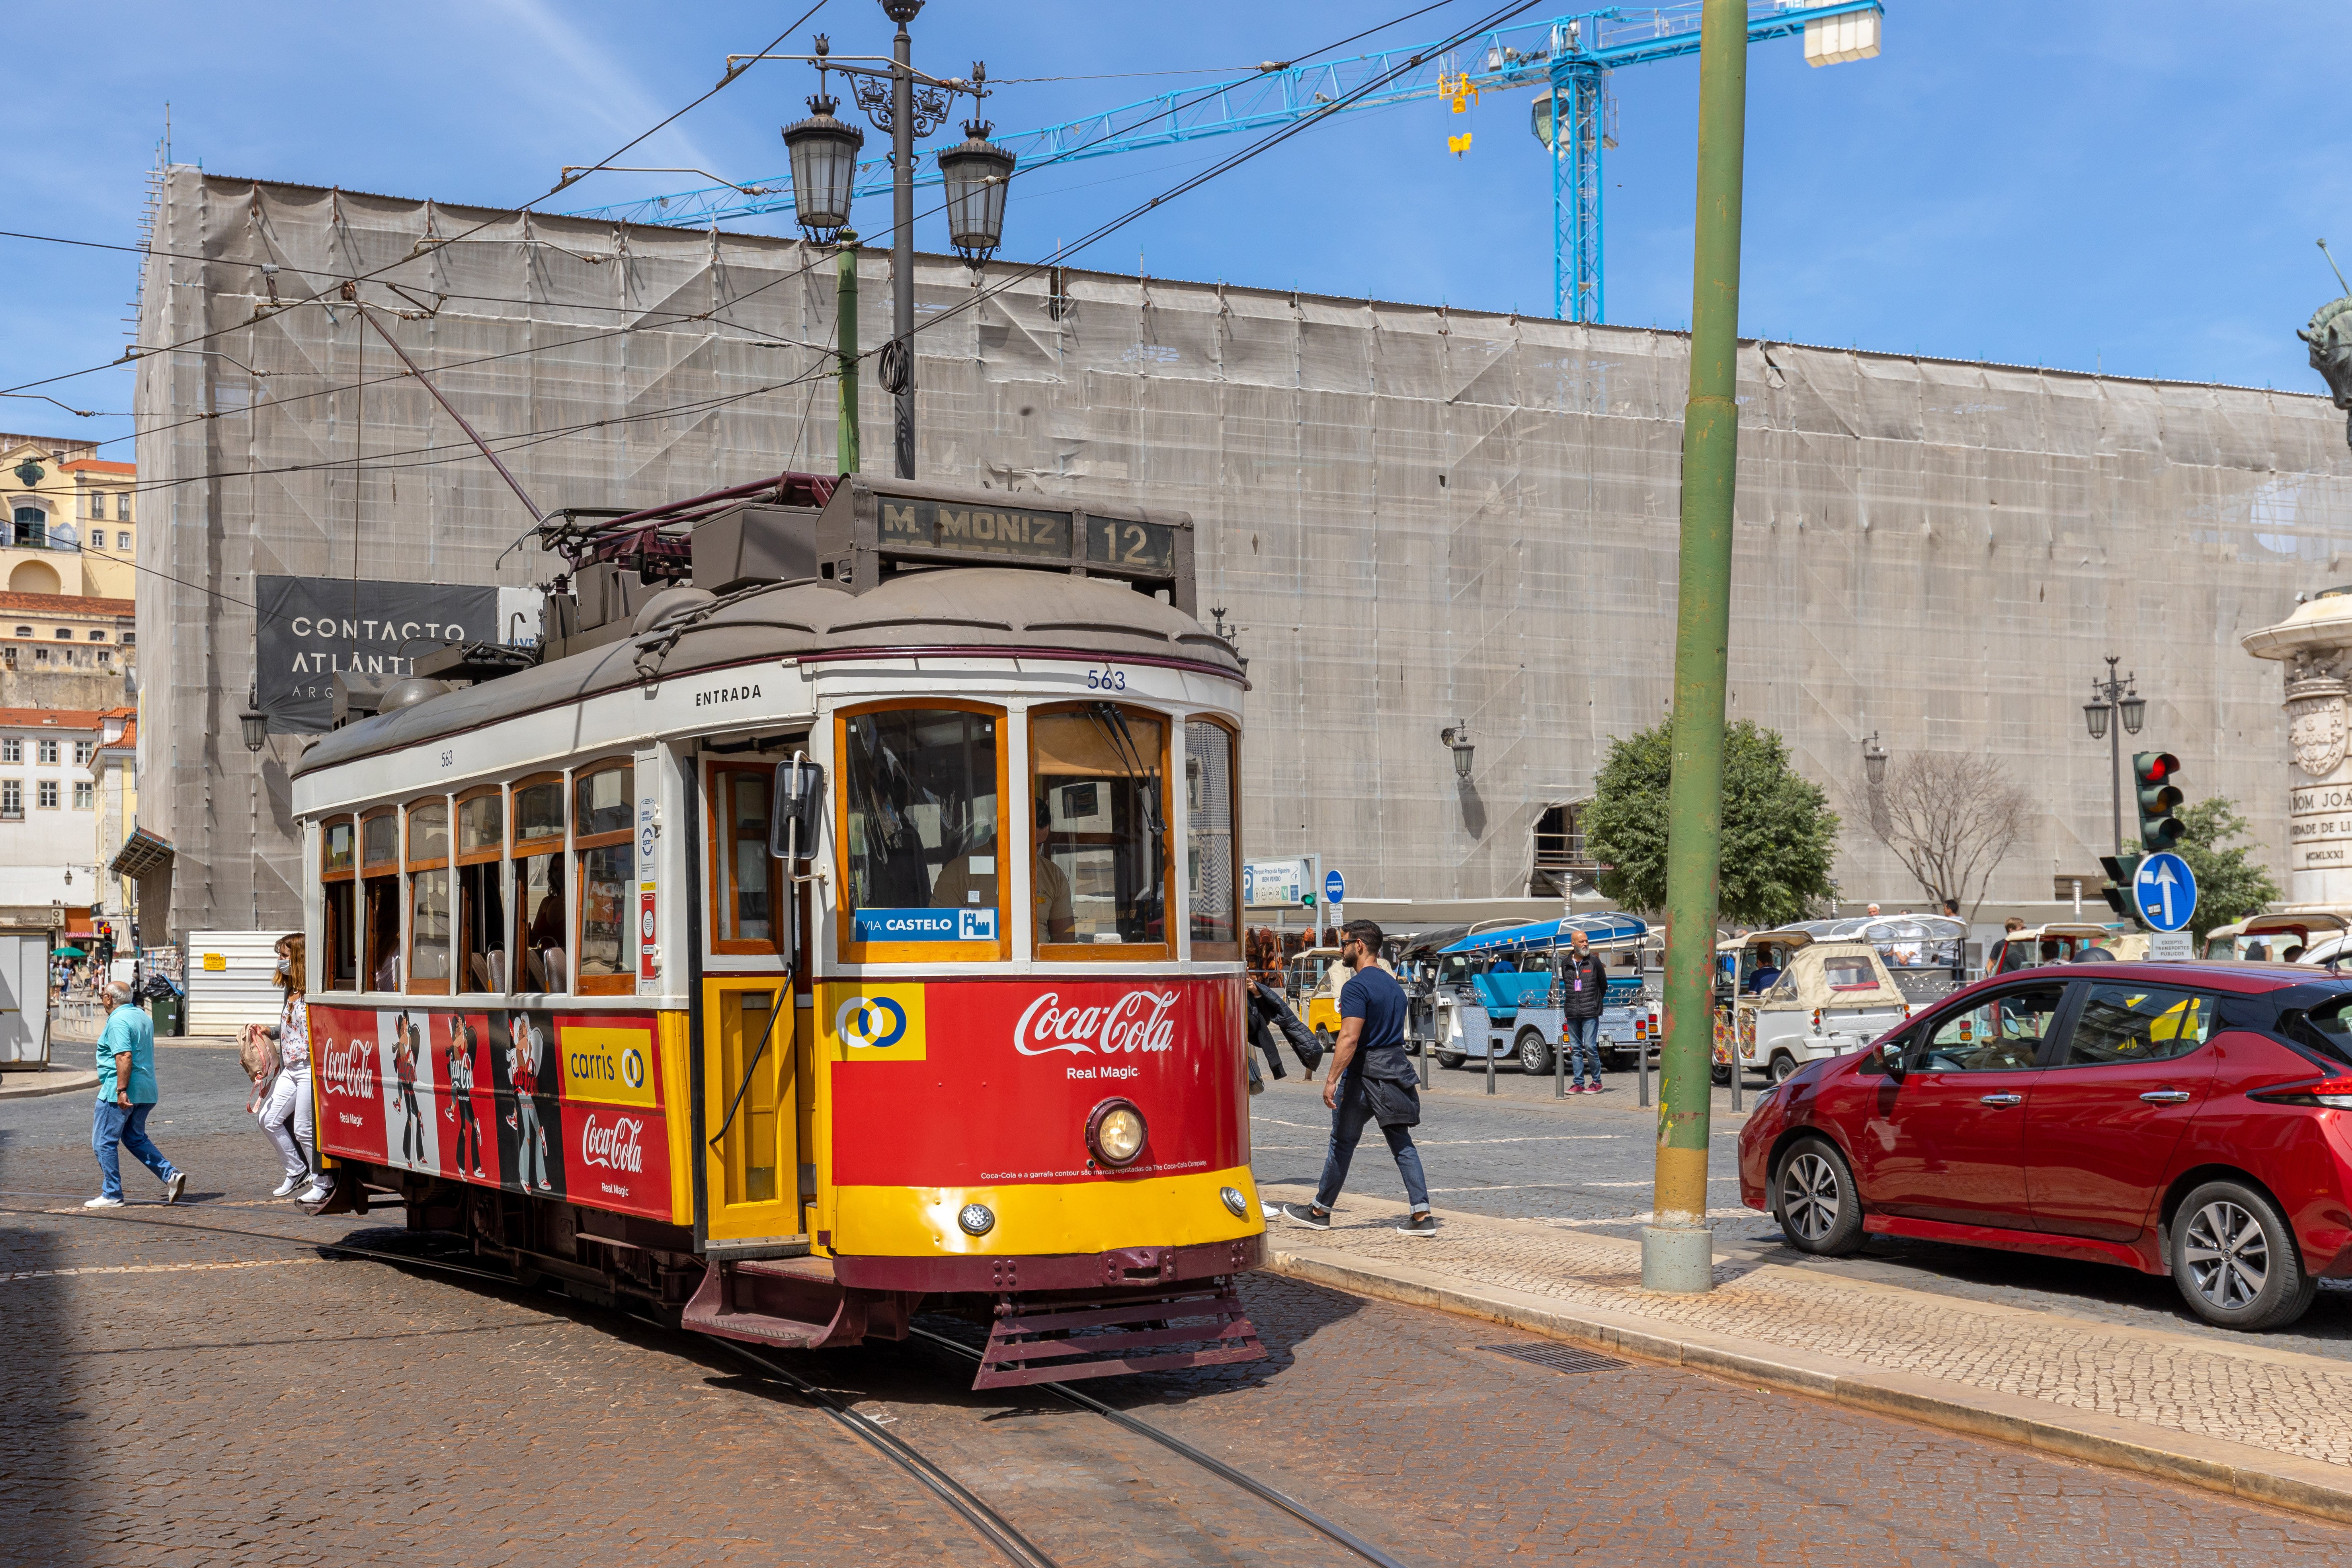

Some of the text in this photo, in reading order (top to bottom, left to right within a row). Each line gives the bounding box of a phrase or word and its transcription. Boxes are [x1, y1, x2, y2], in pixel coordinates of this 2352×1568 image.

[884, 504, 1056, 545] M. MONIZ
[1104, 522, 1147, 565] 12
[292, 617, 465, 641] CONTACTO
[1087, 670, 1125, 691] 563
[696, 684, 761, 707] ENTRADA
[442, 750, 453, 767] 563
[2293, 795, 2314, 810] DOM
[2321, 822, 2334, 833] DE
[2306, 850, 2344, 861] MCMLXXI
[862, 919, 952, 931] VIA CASTELO
[1014, 990, 1181, 1056] Coca-Cola
[1844, 1016, 1883, 1026] PIAGGIO
[323, 1037, 373, 1099] Coca-Cola
[571, 1044, 615, 1081] carris
[1067, 1065, 1138, 1079] Real Magic
[340, 1112, 363, 1127] Real Magic
[582, 1114, 644, 1173] Coca-Cola
[1163, 1162, 1187, 1170] Coca-Cola
[601, 1182, 629, 1197] Real Magic
